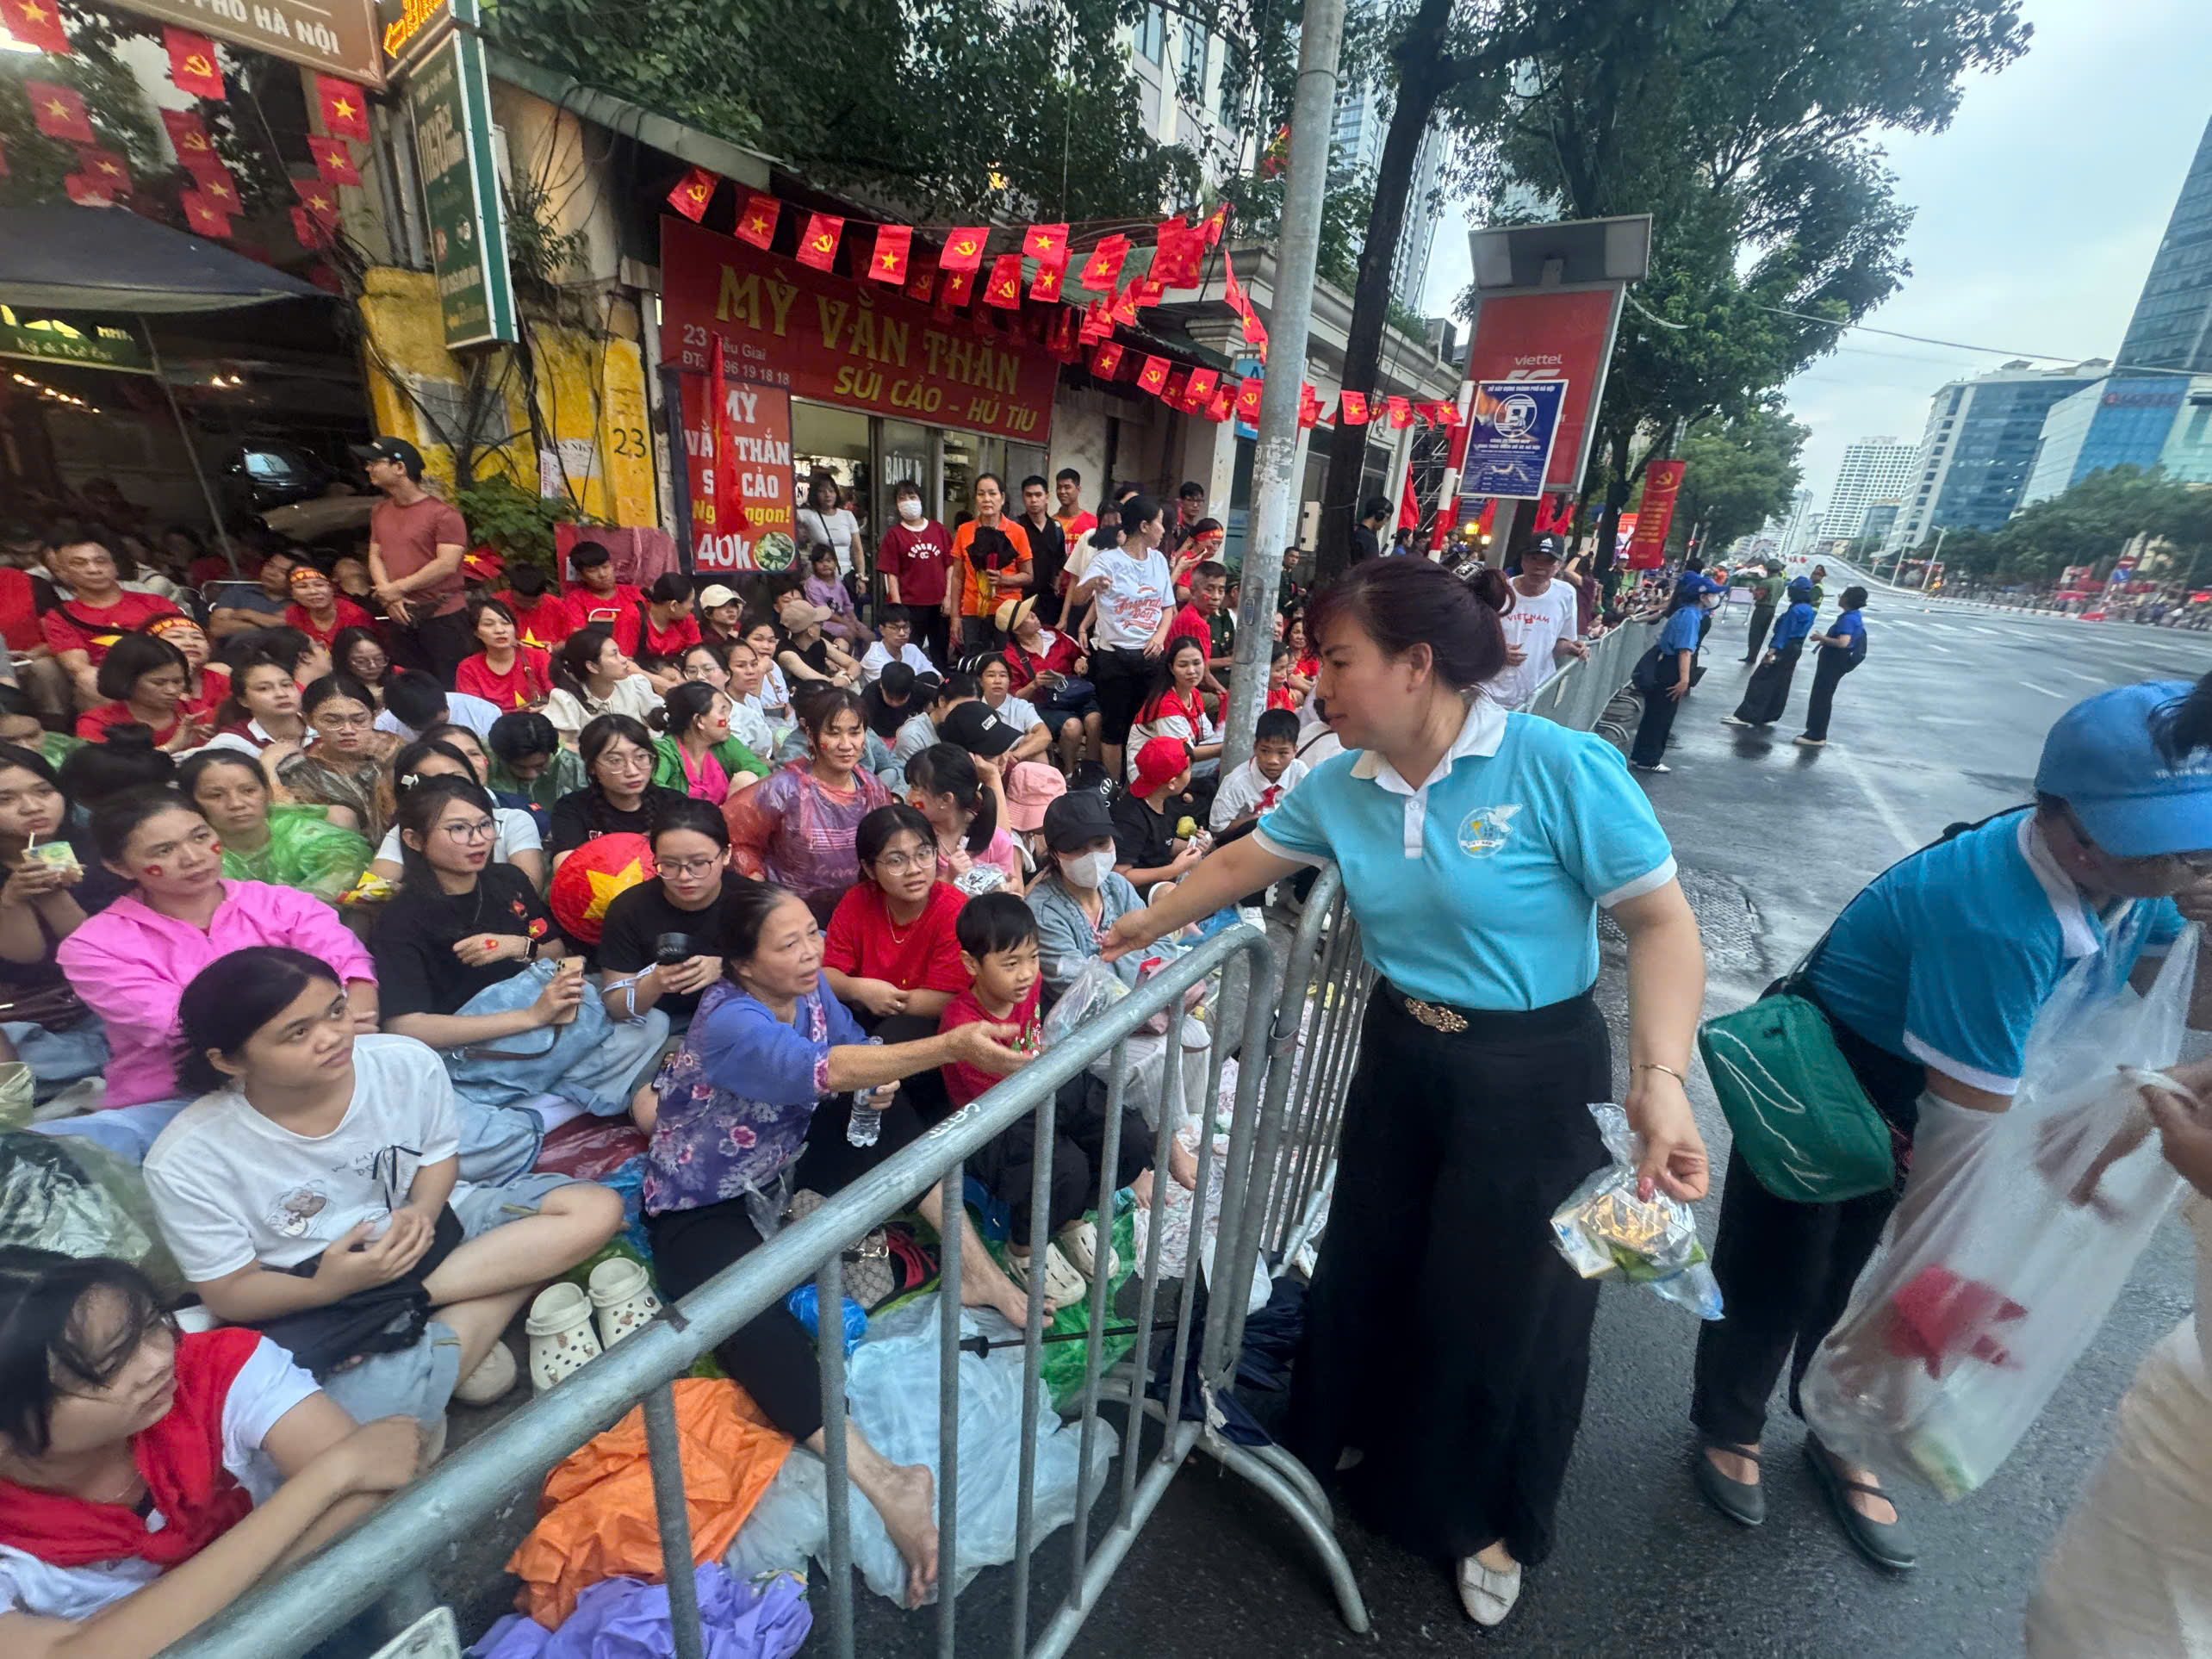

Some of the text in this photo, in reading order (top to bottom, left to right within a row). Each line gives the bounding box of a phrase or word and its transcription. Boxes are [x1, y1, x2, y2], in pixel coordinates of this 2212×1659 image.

[253, 4, 292, 40] HÀ
[295, 19, 341, 55] NỘI
[716, 262, 799, 337] MỲ
[681, 323, 706, 347] 23
[743, 364, 756, 379] 19
[760, 368, 773, 382] 18
[777, 371, 790, 385] 18
[1514, 354, 1563, 366] viettel
[833, 362, 883, 401] SỦI
[890, 374, 942, 413] CẢO
[966, 394, 1000, 425] HỦ
[612, 427, 646, 458] 23
[684, 419, 791, 466] VẰ THẮN
[742, 466, 779, 499] CẢO
[698, 532, 752, 569] 40k
